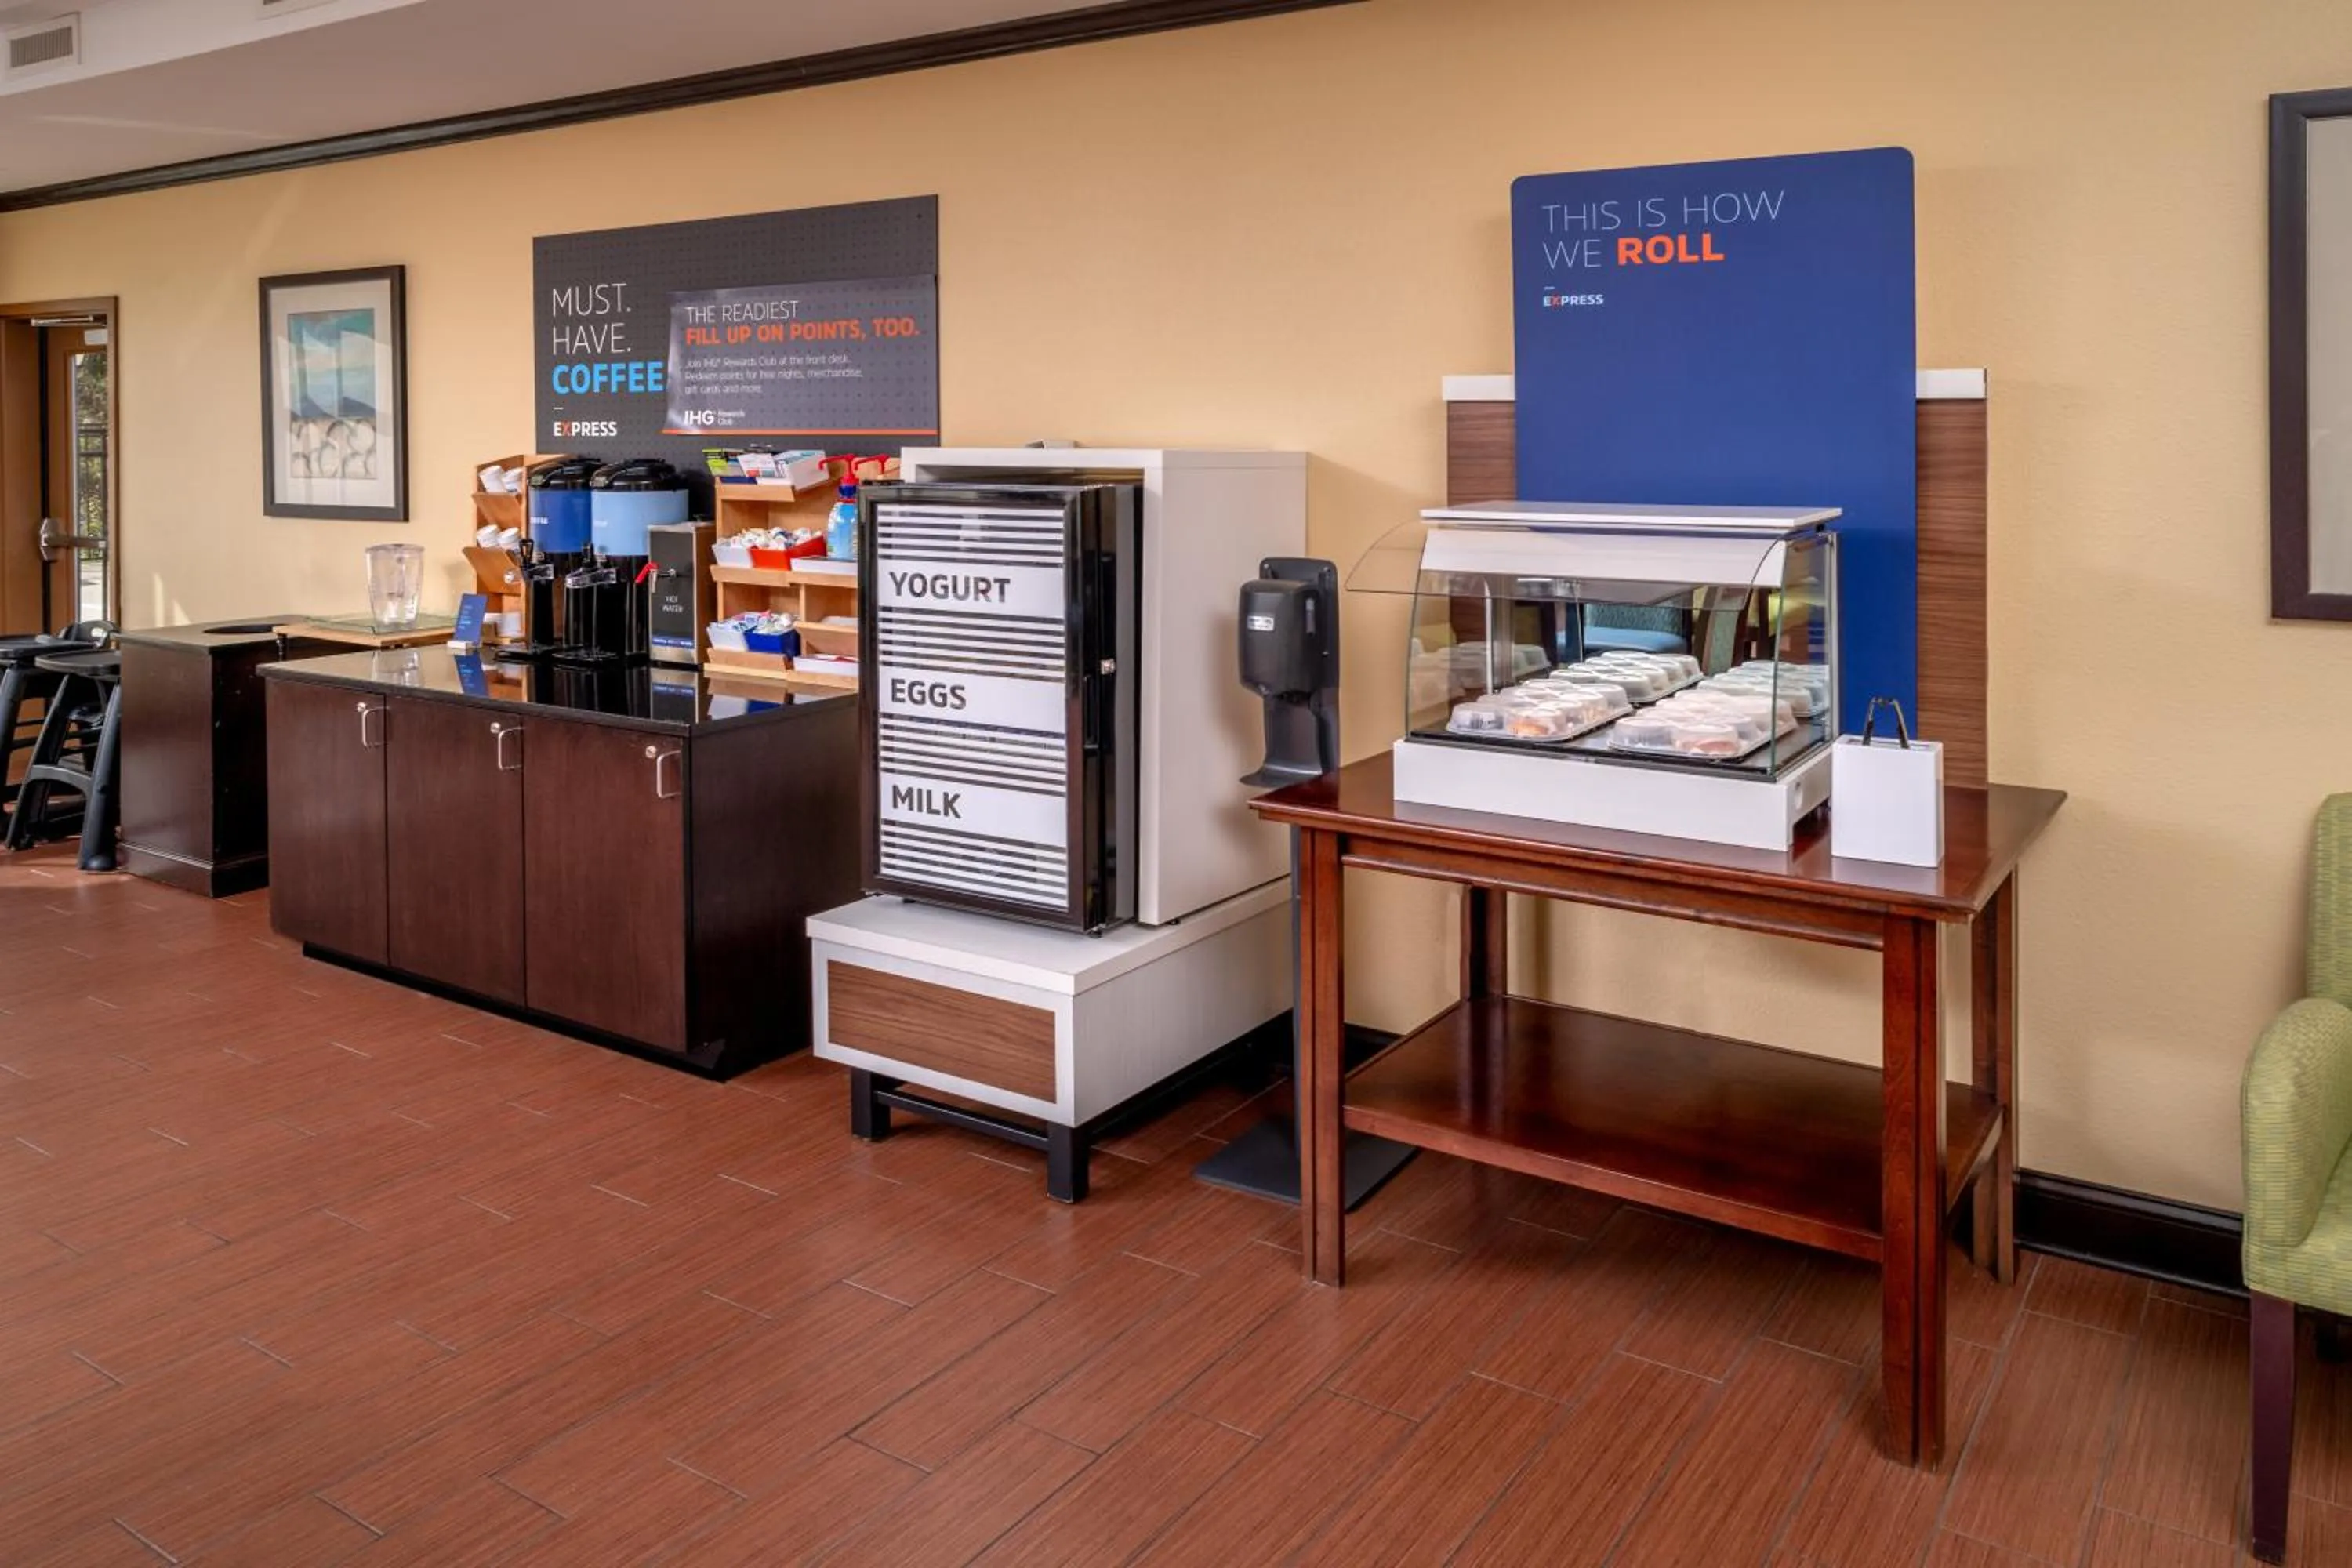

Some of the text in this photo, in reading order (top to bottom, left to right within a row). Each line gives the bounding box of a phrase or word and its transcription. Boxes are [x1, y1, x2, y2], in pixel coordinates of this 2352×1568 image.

[1541, 190, 1784, 233] THIS IS HOW
[1542, 233, 1725, 270] WE ROLL
[553, 283, 632, 317] MUST.
[684, 300, 799, 324] THE READIEST
[1543, 294, 1603, 307] EXPRESS
[553, 322, 632, 355] HAVE.
[686, 315, 920, 345] FILL UP ON POINTS, TOO.
[553, 421, 617, 437] EXPRESS
[890, 572, 1011, 603] YOGURT
[891, 678, 967, 710] EGGS
[892, 785, 961, 819] MILK
